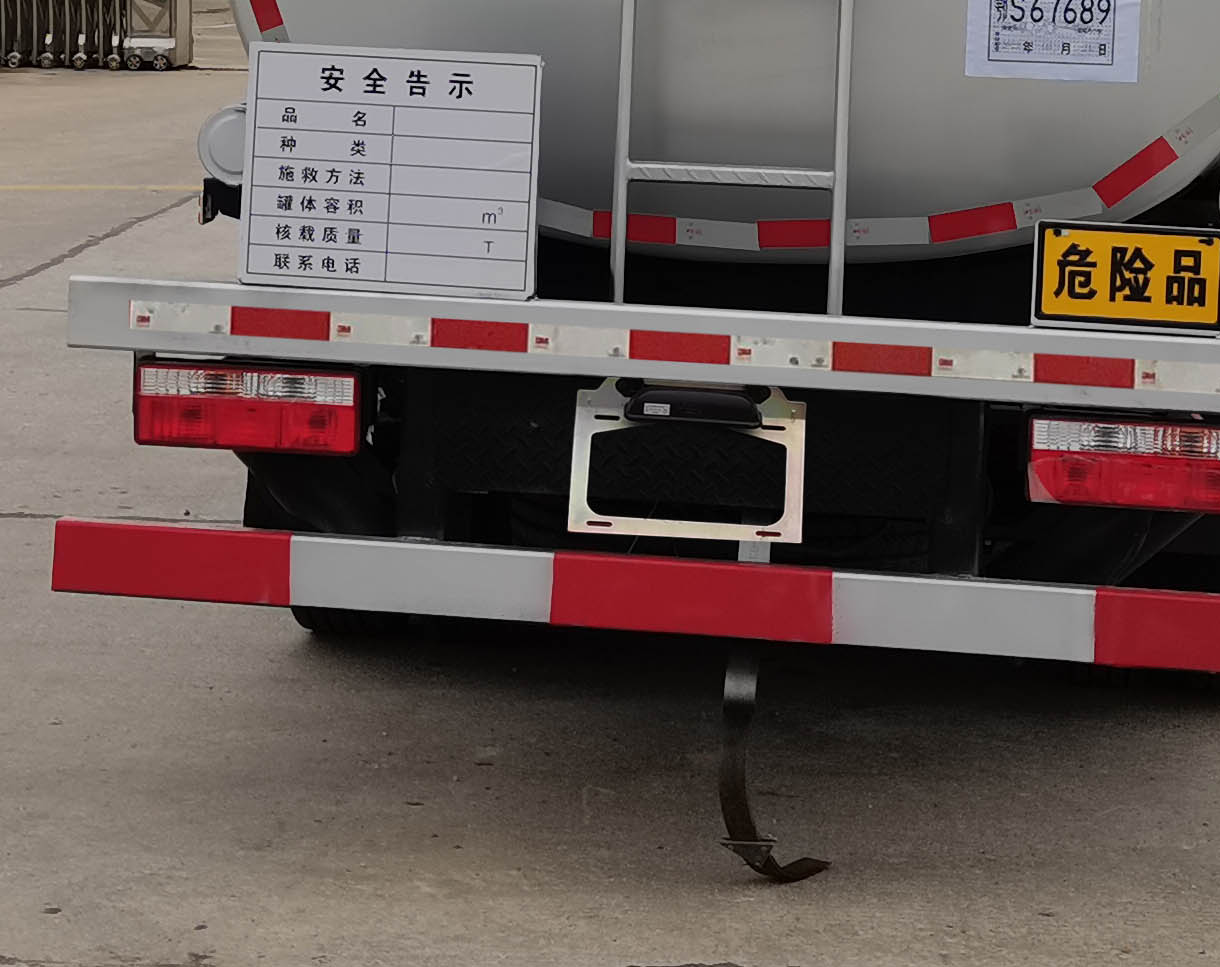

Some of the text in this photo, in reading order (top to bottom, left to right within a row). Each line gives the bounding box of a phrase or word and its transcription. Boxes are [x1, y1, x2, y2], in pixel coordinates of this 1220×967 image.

[320, 65, 473, 99] 安全告示
[278, 165, 365, 186] 施救方法
[276, 195, 364, 216] 罐体容积
[275, 223, 363, 245] 核载质量
[483, 240, 494, 254] T
[273, 253, 361, 274] 联系电话
[1053, 242, 1207, 307] 危险品
